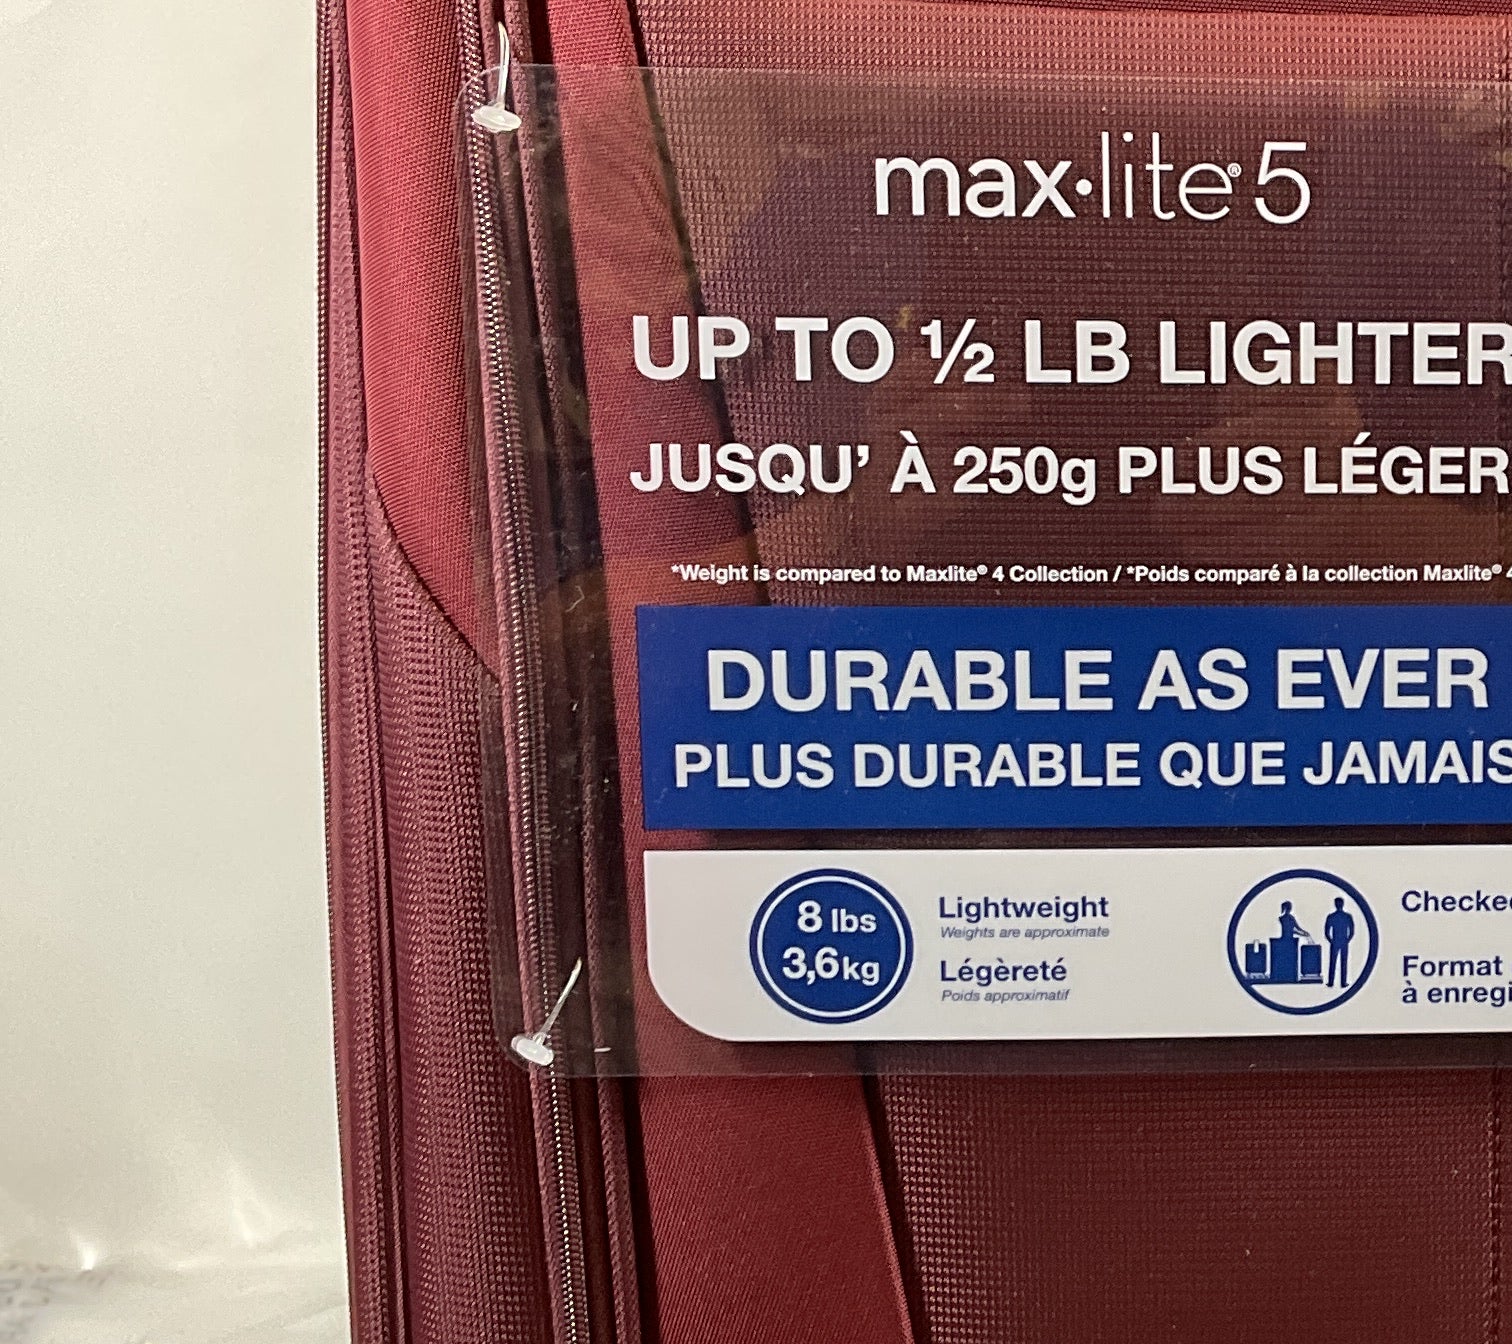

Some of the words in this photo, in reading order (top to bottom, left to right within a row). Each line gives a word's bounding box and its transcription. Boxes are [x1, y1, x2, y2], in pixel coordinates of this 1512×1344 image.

[1253, 140, 1311, 225] 5
[632, 314, 751, 381] UP
[774, 316, 895, 383] TO
[1024, 319, 1130, 384] LB
[889, 430, 937, 493] À
[953, 445, 1096, 506] 250g
[1118, 445, 1283, 495] PLUS
[753, 564, 770, 581] is
[775, 564, 875, 585] compared
[880, 566, 900, 581] to
[992, 566, 1004, 581] 4
[1009, 564, 1109, 582] Collection
[1194, 563, 1280, 584] comparé
[1285, 563, 1297, 581] à
[1302, 565, 1318, 581] la
[1323, 564, 1417, 581] collection
[707, 649, 1114, 712] DURABLE
[1137, 647, 1249, 711] AS
[1277, 648, 1489, 710] EVER
[675, 742, 834, 789] PLUS
[854, 742, 1141, 788] DURABLE
[1159, 741, 1286, 789] QUE
[796, 899, 822, 933] 8
[831, 907, 877, 933] lbs
[938, 895, 1109, 923] Lightweight
[940, 926, 994, 940] Weights
[999, 929, 1020, 937] are
[1024, 926, 1109, 939] approximate
[940, 957, 1066, 987] Légèreté
[1402, 954, 1503, 976] Format
[941, 989, 979, 1001] Poids
[983, 988, 1070, 1003] approximatif
[1401, 980, 1417, 1003] à
